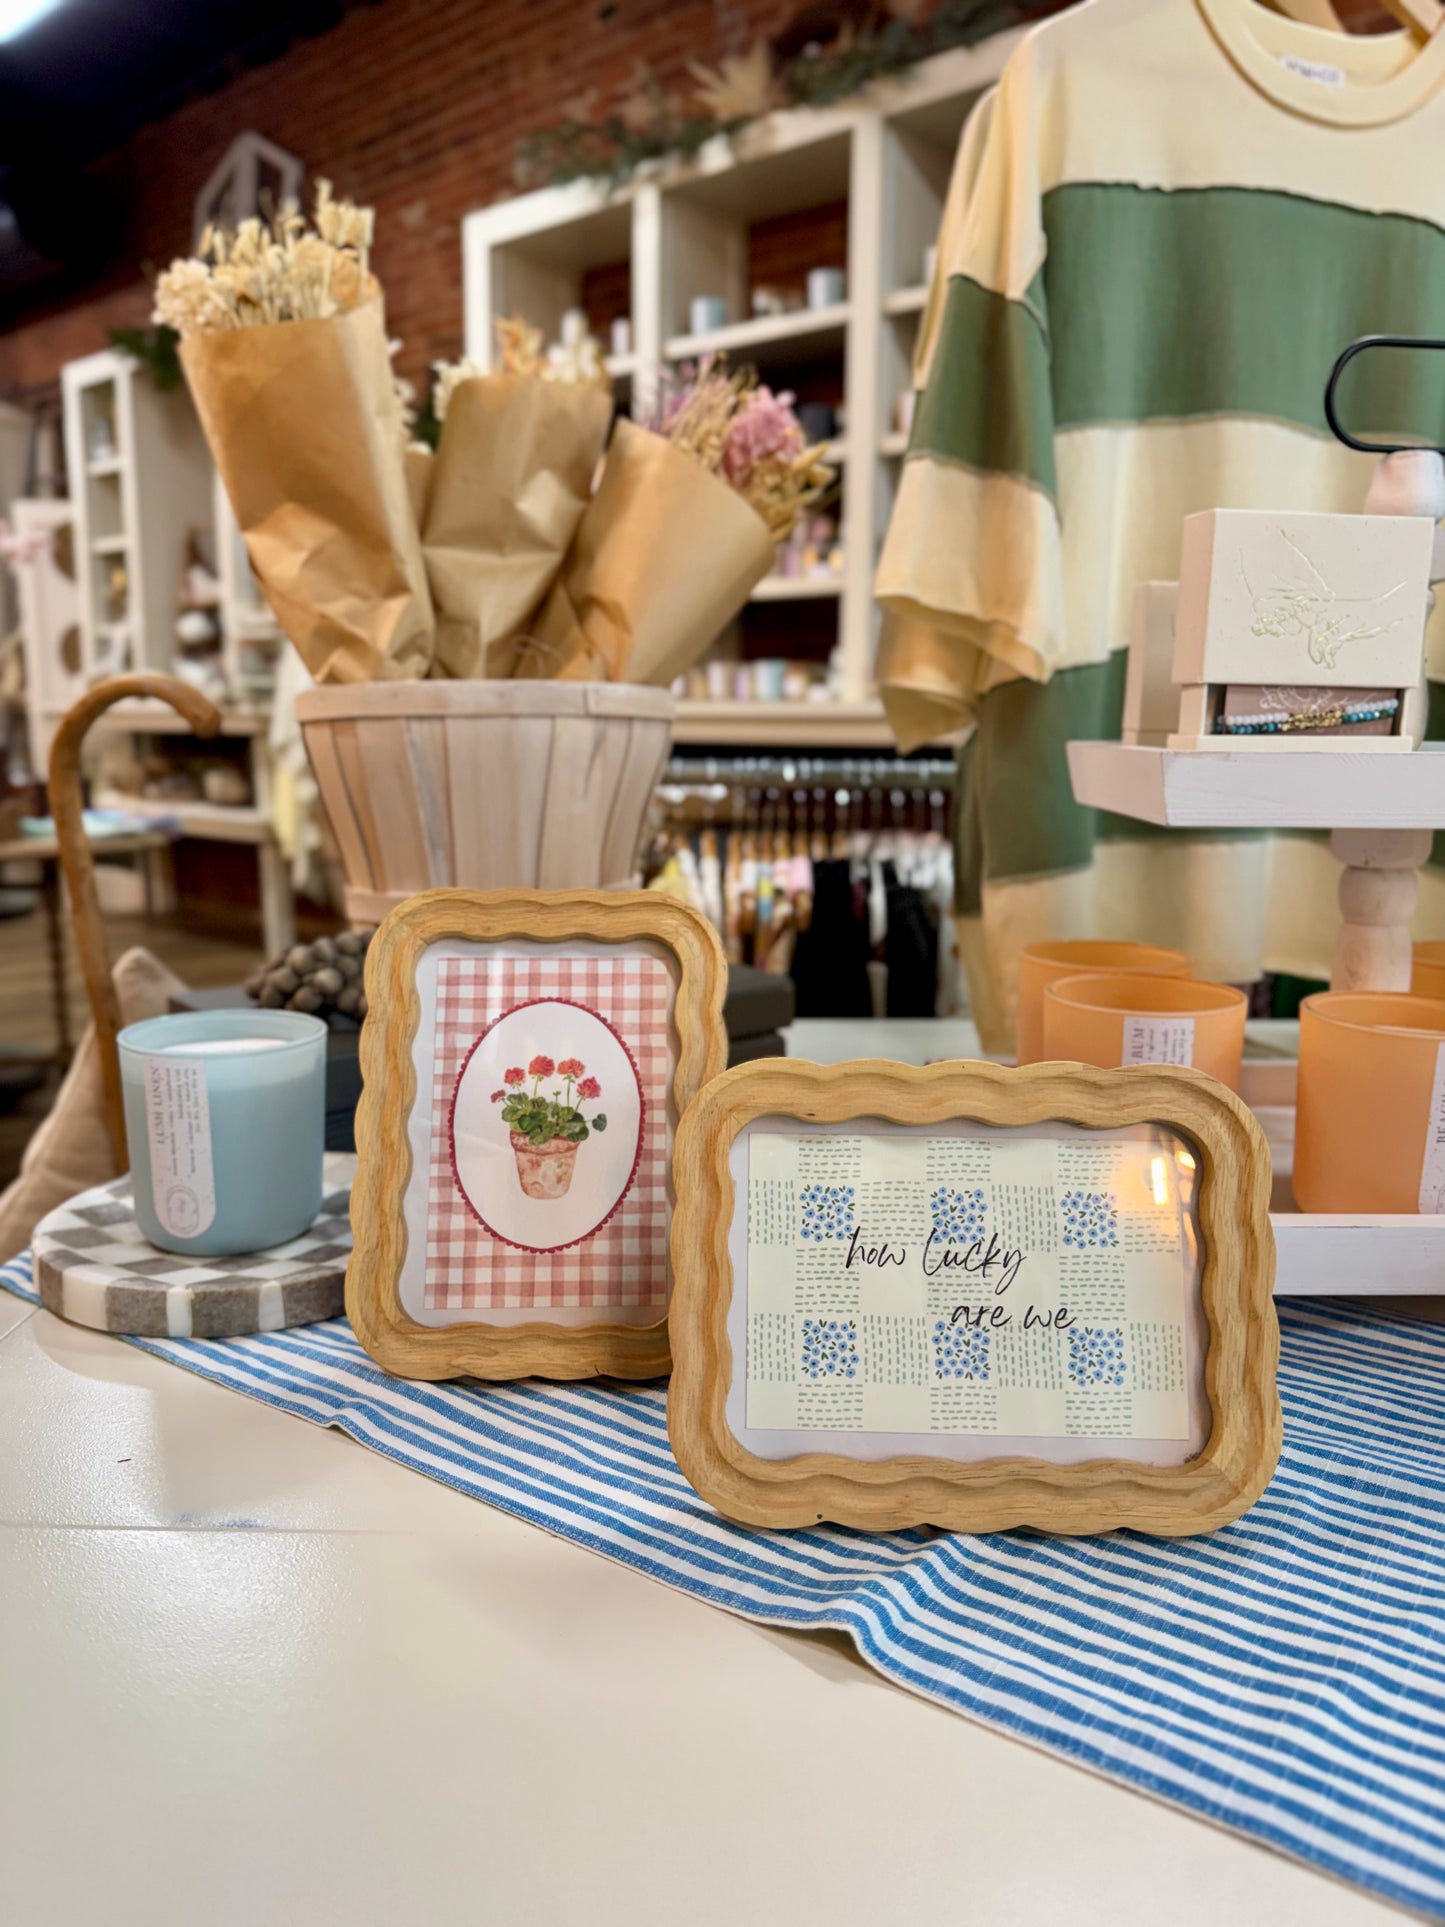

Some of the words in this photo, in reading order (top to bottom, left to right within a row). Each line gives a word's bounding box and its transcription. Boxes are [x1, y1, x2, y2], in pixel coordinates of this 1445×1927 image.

[1131, 1027, 1144, 1058] BUM
[845, 1225, 906, 1269] how
[922, 1227, 1027, 1295] lucky
[951, 1304, 1013, 1328] are
[1023, 1304, 1077, 1330] we
